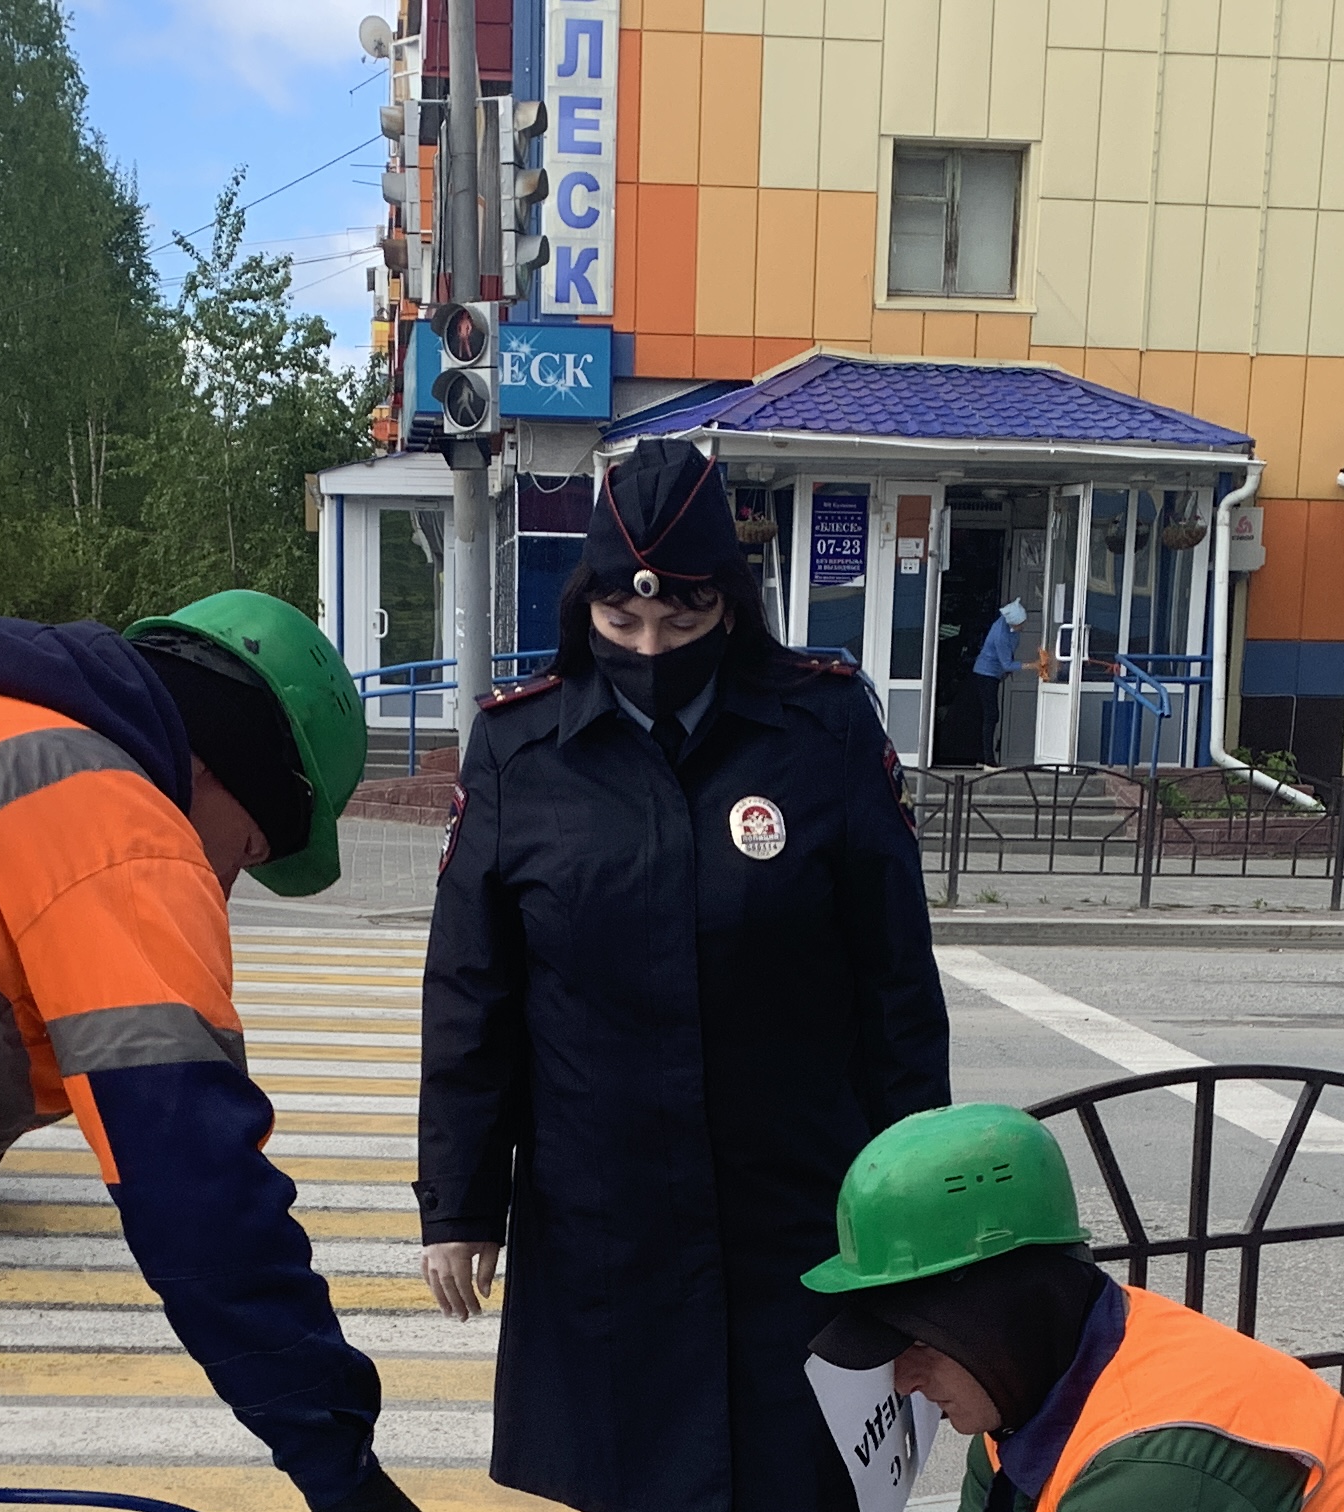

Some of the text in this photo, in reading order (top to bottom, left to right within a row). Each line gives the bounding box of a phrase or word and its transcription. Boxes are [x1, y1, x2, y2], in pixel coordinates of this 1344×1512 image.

[555, 0, 604, 305] ЛЕСК
[437, 350, 594, 388] ЕСК
[816, 538, 861, 555] 07-23
